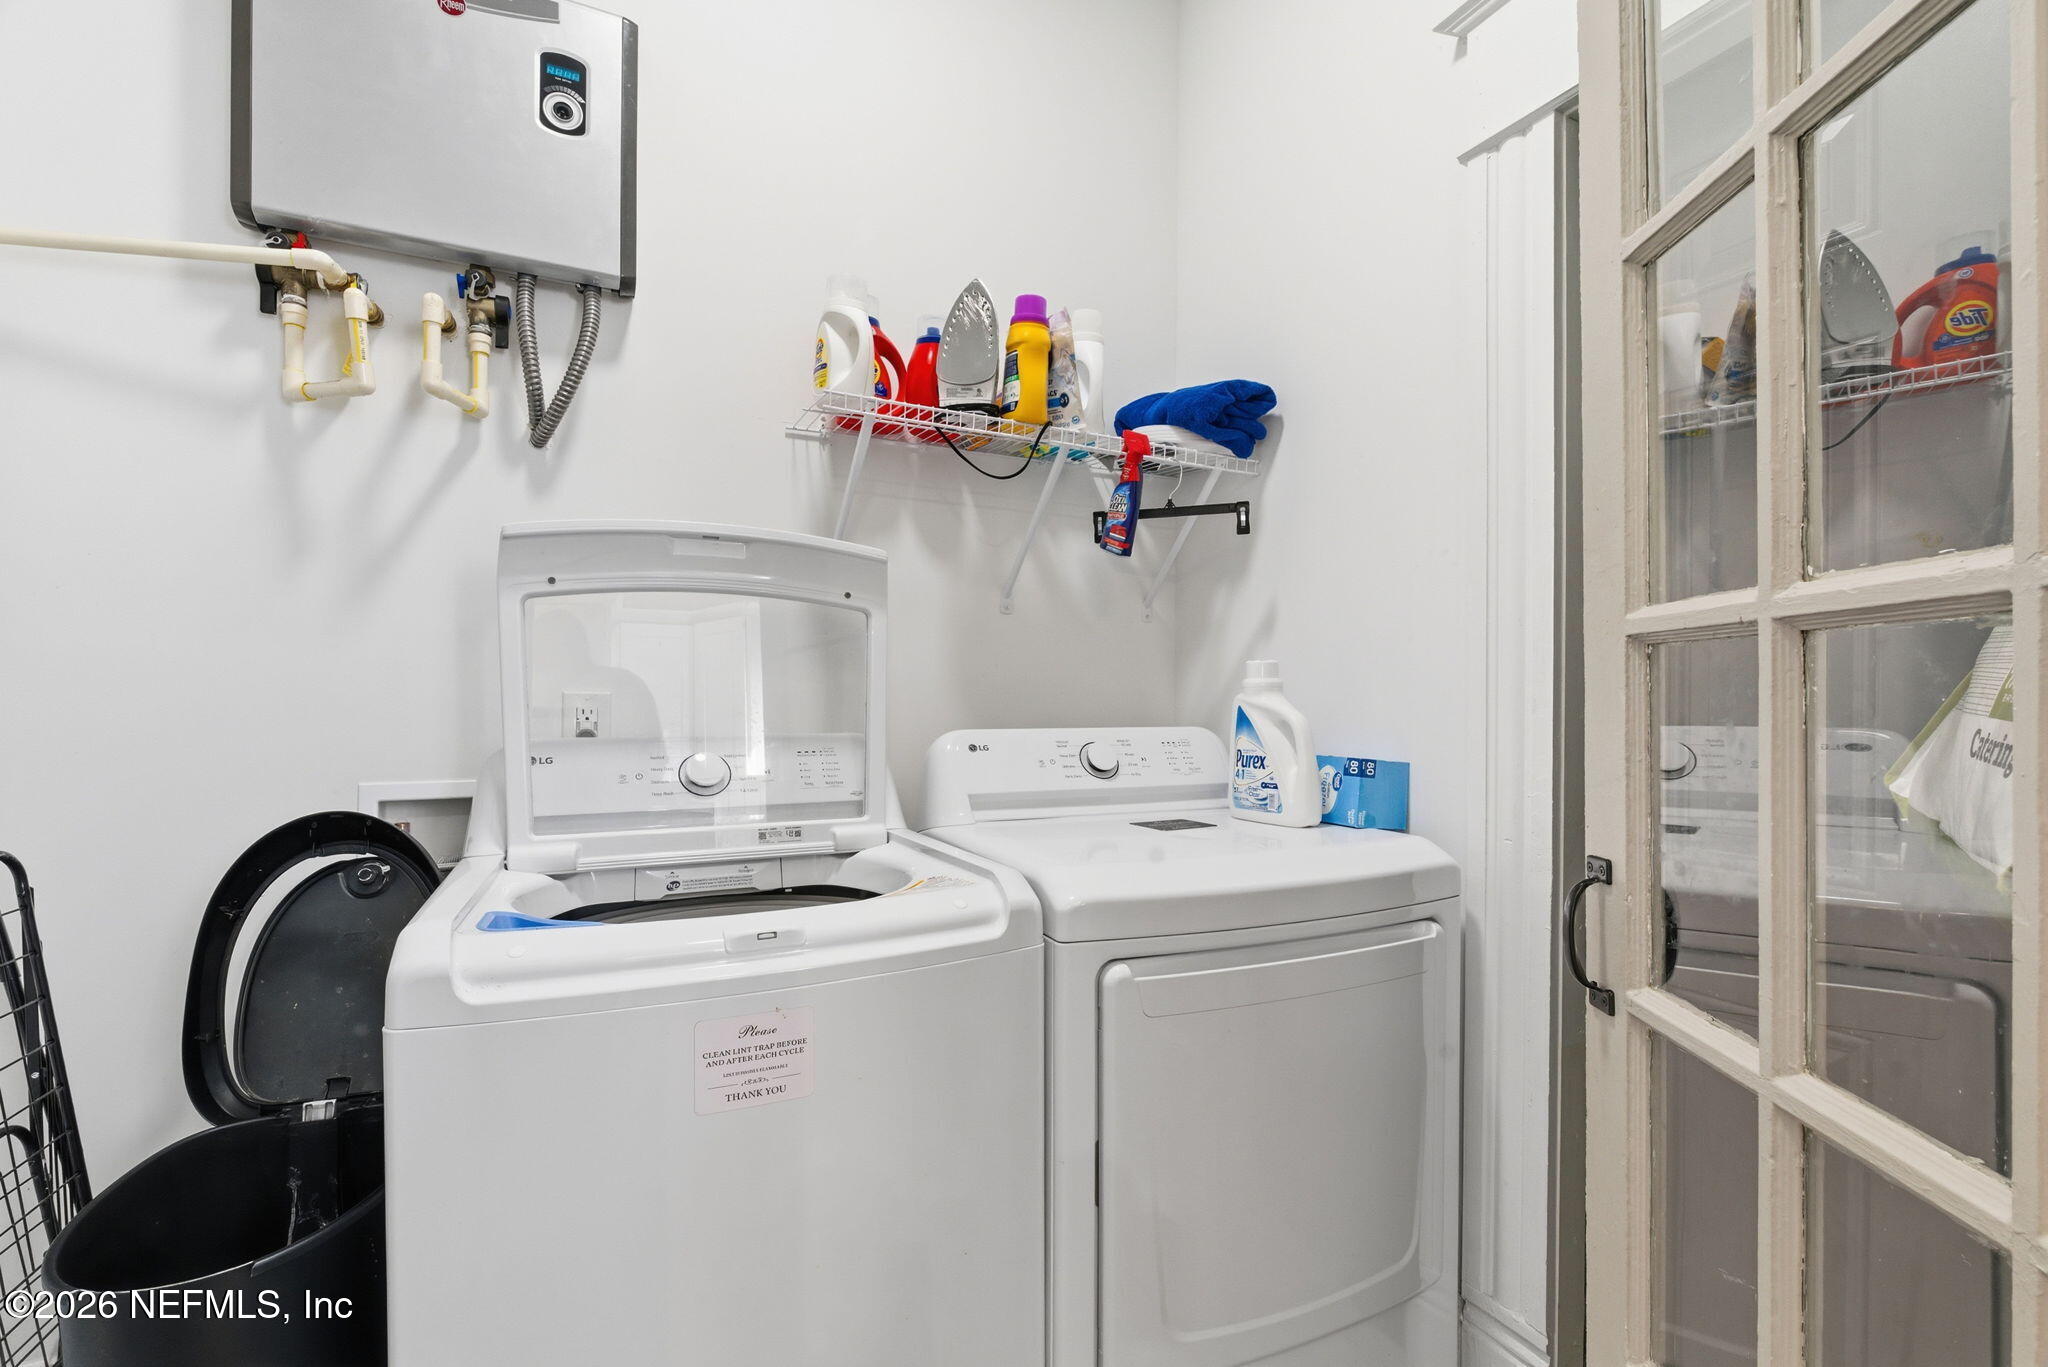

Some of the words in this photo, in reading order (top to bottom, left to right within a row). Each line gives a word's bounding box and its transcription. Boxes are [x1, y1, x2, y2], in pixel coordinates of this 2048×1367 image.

[979, 744, 990, 752] LG
[538, 756, 554, 765] LG
[1235, 748, 1267, 770] Purex
[1349, 760, 1359, 774] 80
[1366, 761, 1375, 776] 80
[738, 1024, 778, 1039] Please
[702, 1048, 732, 1060] CLEAN
[732, 1046, 752, 1056] LINT
[753, 1042, 775, 1053] TRAP
[776, 1037, 808, 1050] BEFORE
[705, 1059, 725, 1068] AND
[725, 1054, 753, 1066] AFTER
[754, 1051, 777, 1063] EACH
[778, 1046, 805, 1058] CYCLE
[725, 1088, 764, 1102] THANK
[765, 1084, 787, 1097] YOU
